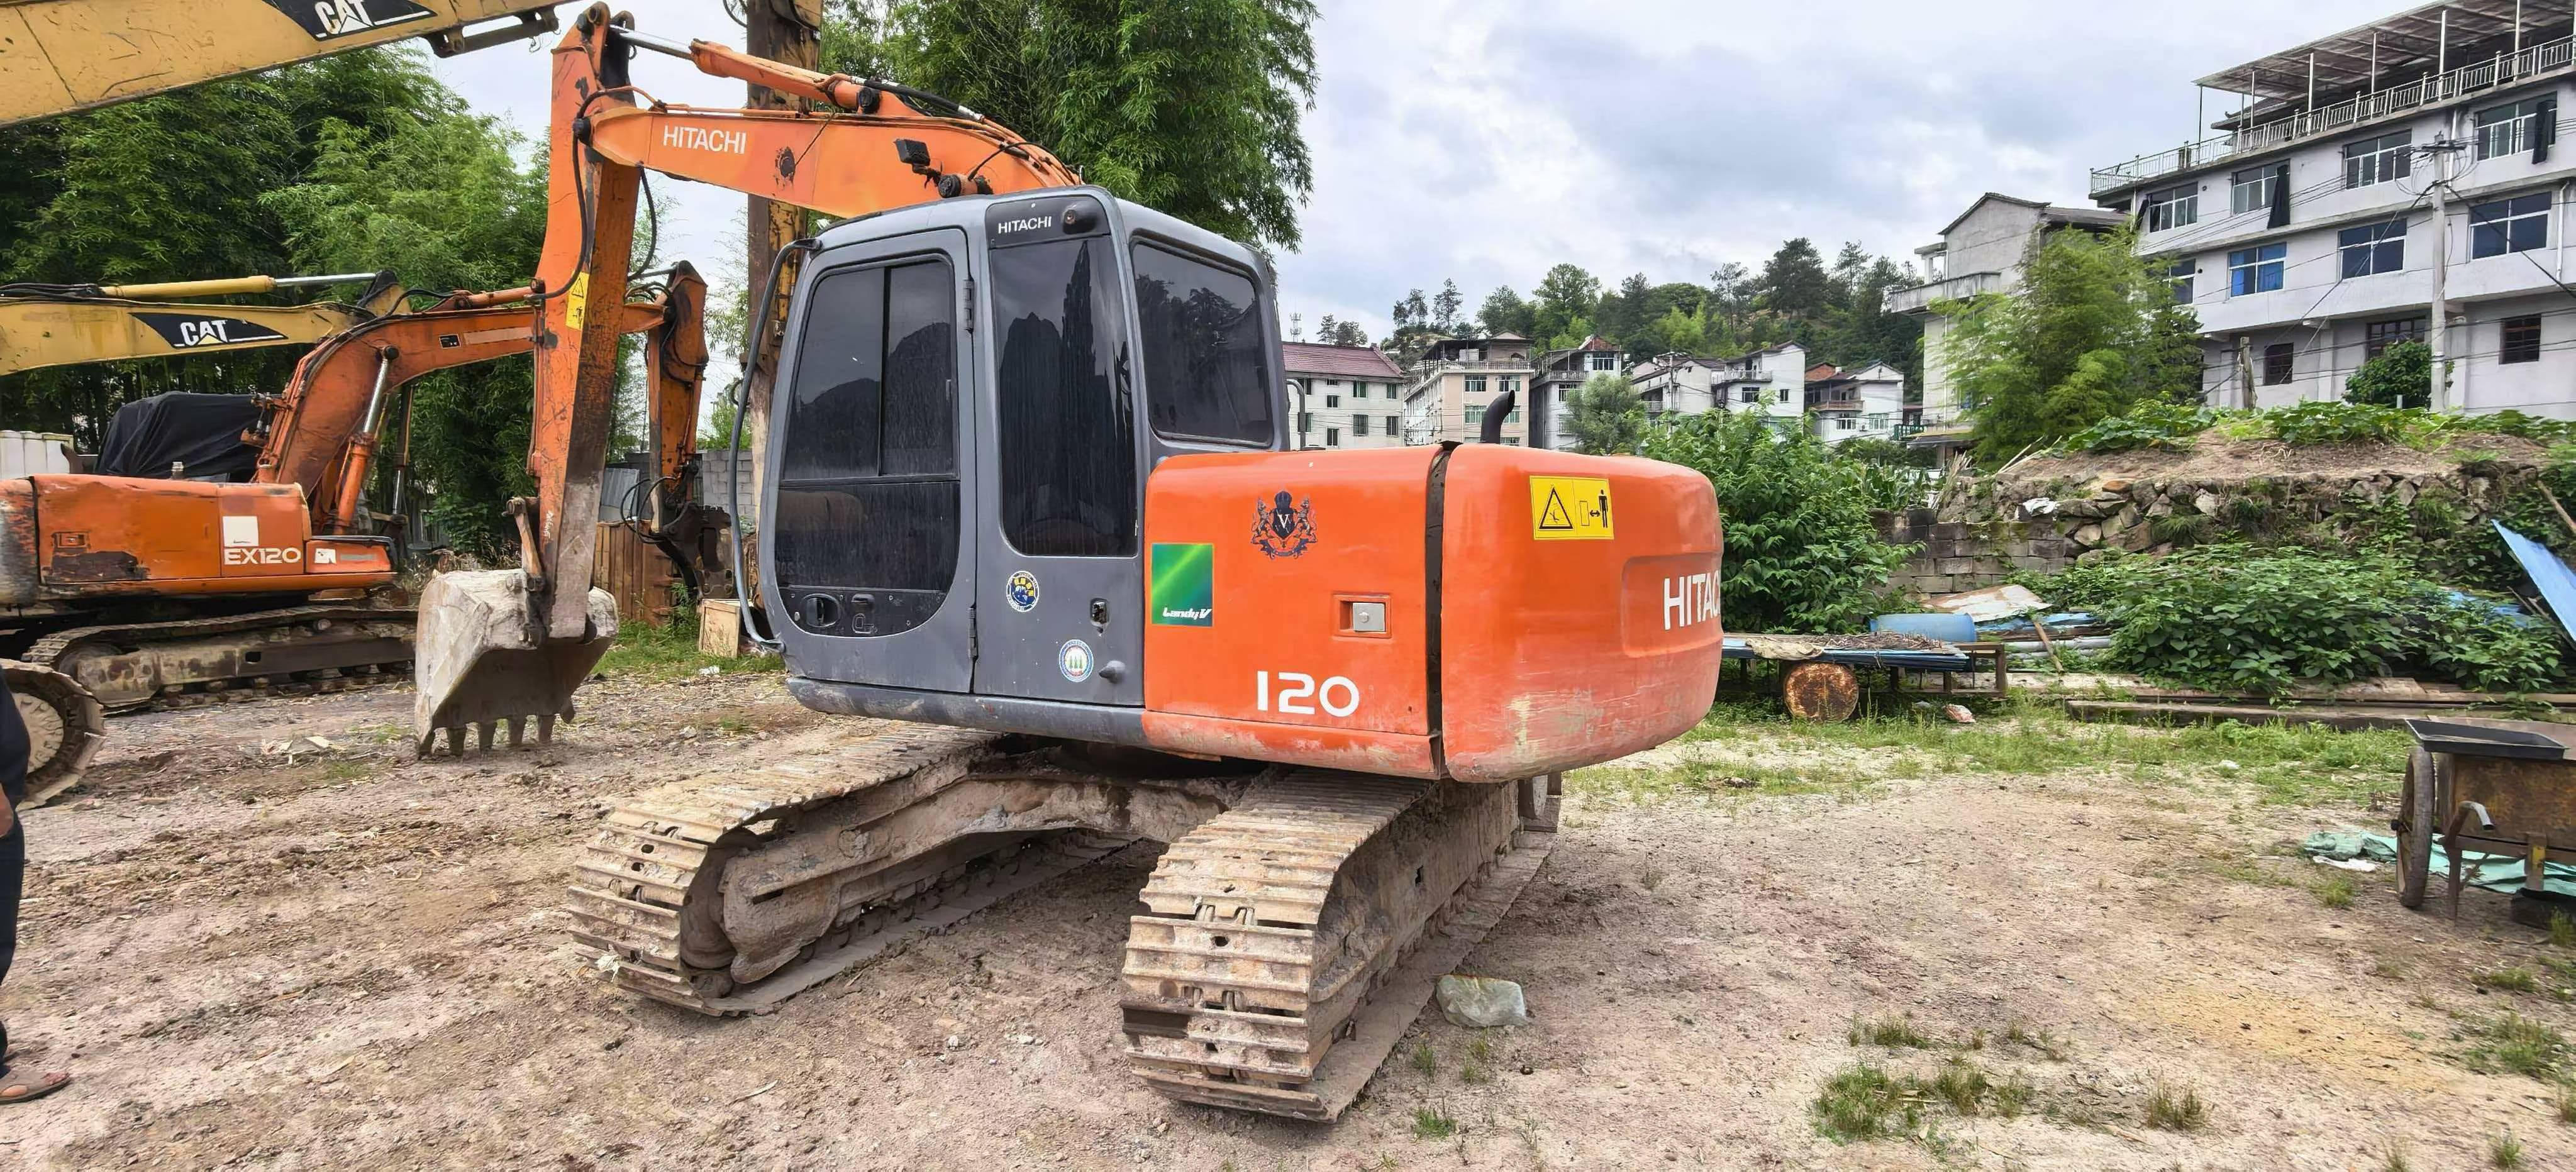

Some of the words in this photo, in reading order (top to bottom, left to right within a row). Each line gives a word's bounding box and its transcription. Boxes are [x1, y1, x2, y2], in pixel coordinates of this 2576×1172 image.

[315, 0, 374, 35] CAT
[663, 125, 747, 154] HITACHI
[998, 216, 1052, 234] HITACHI
[180, 319, 228, 346] CAT
[225, 548, 301, 565] EX120
[1664, 570, 1721, 630] HITAC
[1257, 670, 1360, 717] 120
